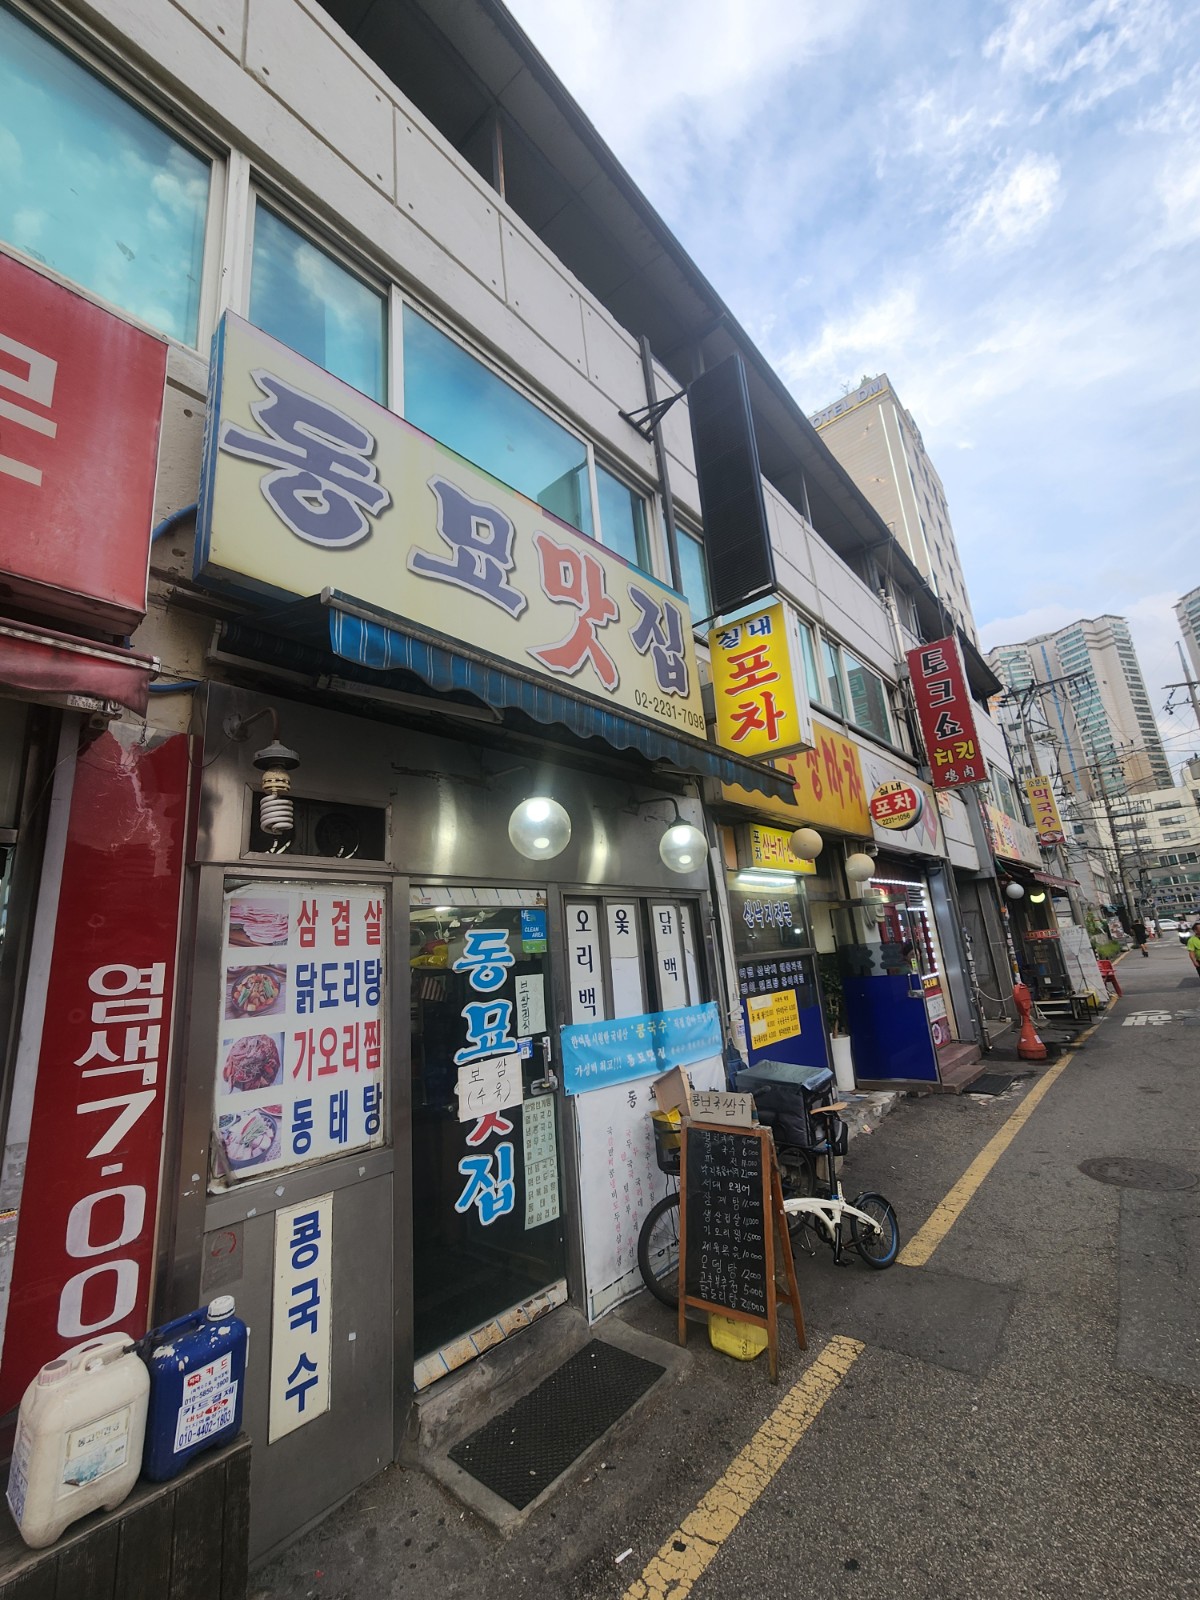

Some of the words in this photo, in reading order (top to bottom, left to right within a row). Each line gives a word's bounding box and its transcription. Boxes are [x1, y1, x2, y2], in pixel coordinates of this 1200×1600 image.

[220, 368, 689, 698] 동묘맛집
[716, 615, 772, 650] 실내
[635, 689, 705, 731] 02-2231-7098
[724, 644, 787, 742] 포차
[920, 648, 964, 741] 토크쇼
[933, 738, 976, 767] 치킨
[875, 792, 913, 817] 포차
[878, 781, 902, 796] 실내
[1033, 788, 1057, 828] 막국수
[297, 899, 382, 948] 삼겹살
[743, 899, 793, 929] 산낙지전문
[296, 958, 382, 1014] 닭도리탕
[73, 963, 166, 1086] 염색
[292, 1019, 382, 1082] 가오리찜
[469, 1058, 507, 1084] 보쌈
[292, 1082, 382, 1155] 동태탕
[728, 1182, 750, 1196] 오징어
[285, 1210, 321, 1413] 콩국수
[179, 1410, 231, 1447] 010-4402-1803
